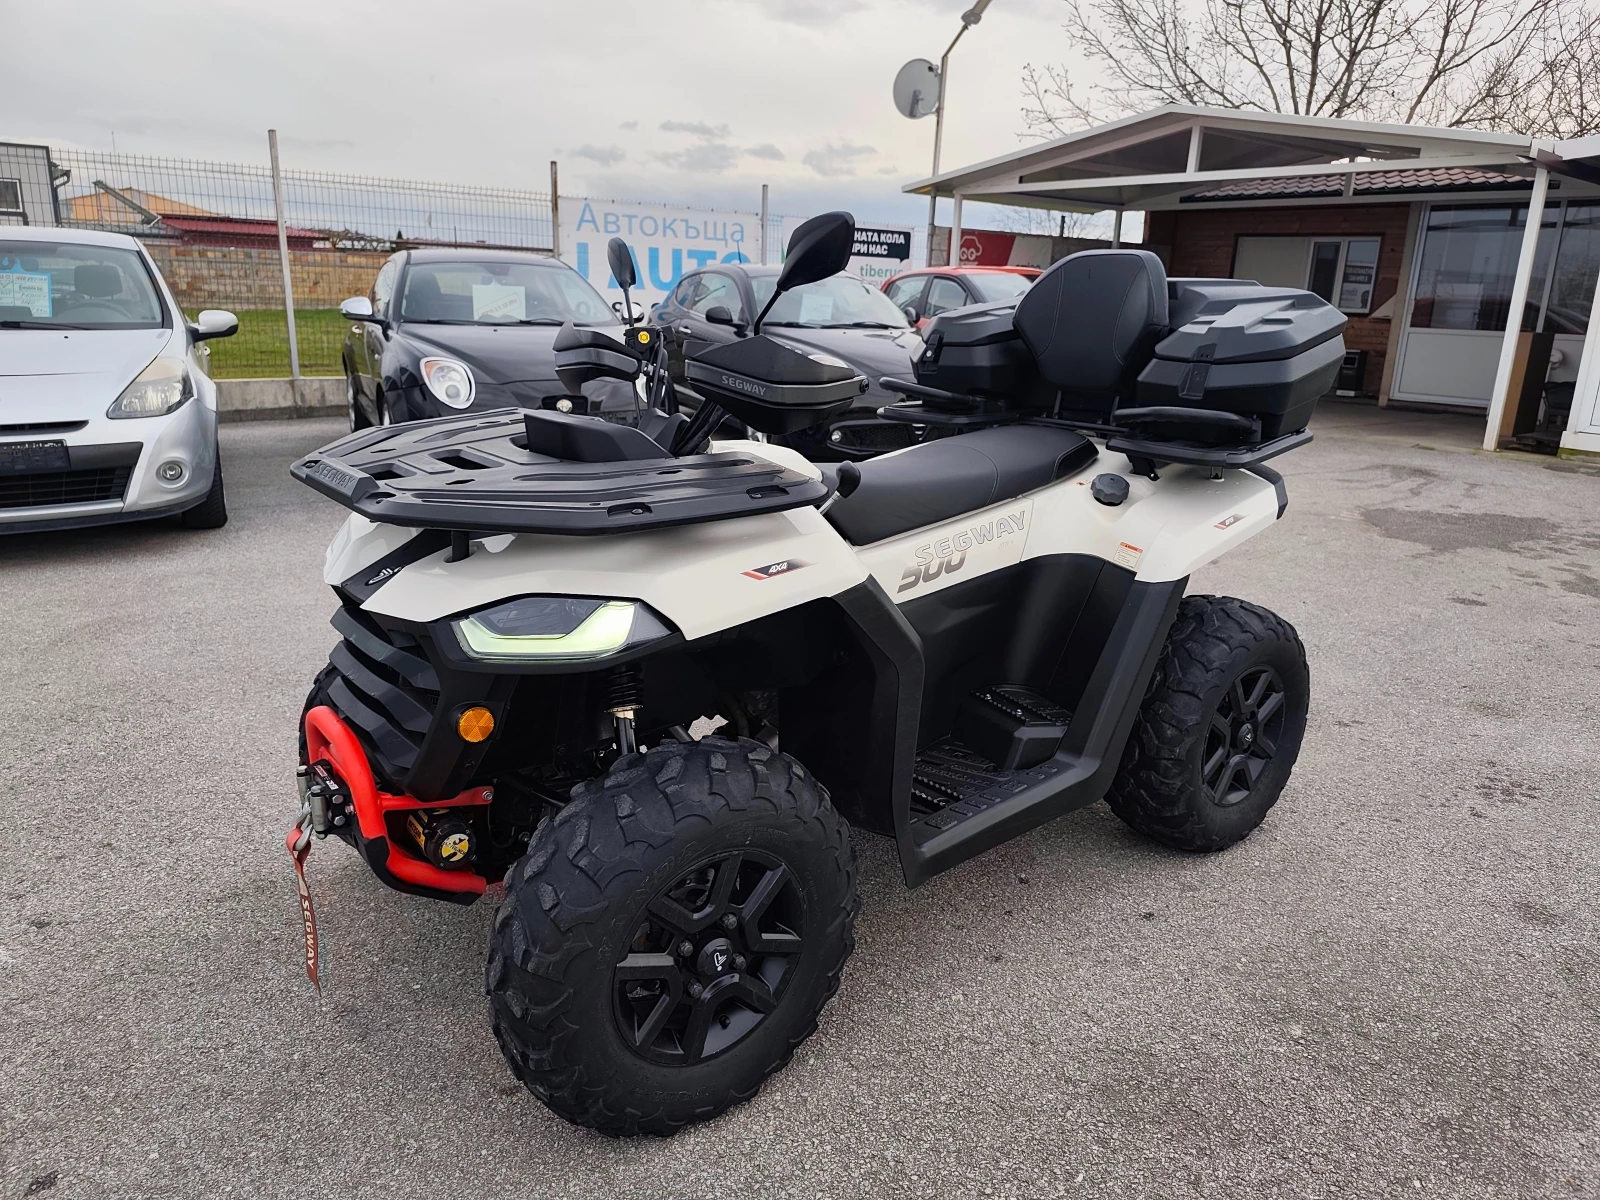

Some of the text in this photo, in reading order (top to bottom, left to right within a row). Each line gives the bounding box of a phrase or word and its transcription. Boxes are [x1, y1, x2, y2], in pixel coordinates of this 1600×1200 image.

[575, 202, 746, 248] Автокъща
[853, 230, 906, 245] НАТА КОЛА
[868, 244, 889, 255] НАС
[721, 375, 767, 396] SEGWAY
[314, 463, 355, 489] SEGWAY
[914, 510, 1026, 567] SEGWAY
[302, 898, 315, 968] SEGWAY
